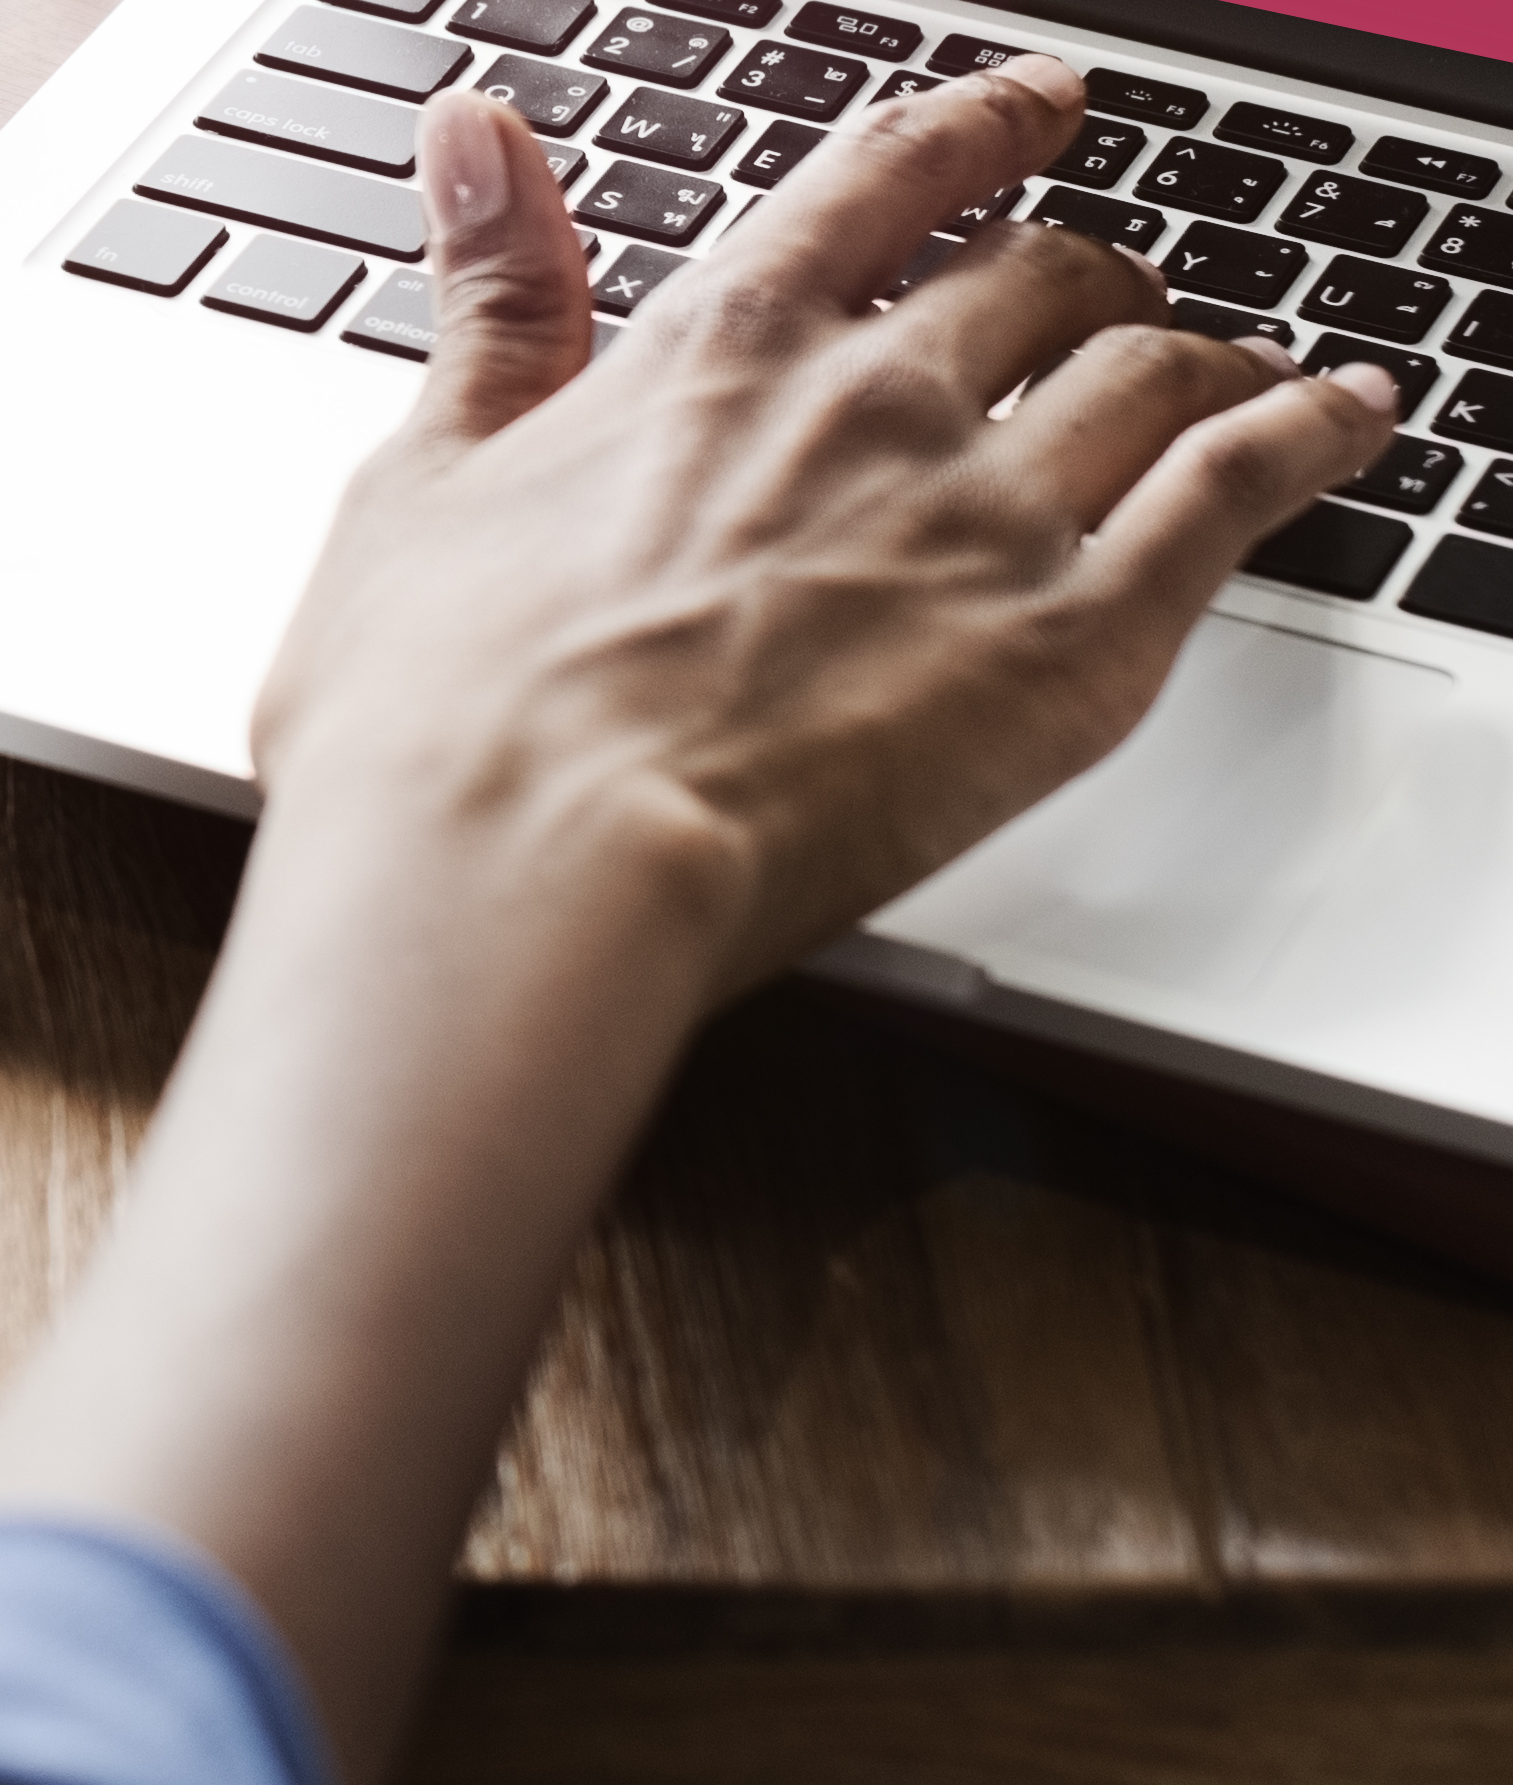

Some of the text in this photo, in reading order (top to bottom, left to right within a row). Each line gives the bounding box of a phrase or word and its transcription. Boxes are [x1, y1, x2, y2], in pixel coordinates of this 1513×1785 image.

[739, 4, 758, 14] F2
[284, 40, 322, 59] tab
[603, 37, 630, 54] 2
[880, 37, 898, 47] F3
[742, 71, 765, 86] 3
[223, 103, 277, 127] caps
[1166, 105, 1185, 115] F5
[282, 118, 331, 141] lock
[621, 116, 661, 138] W
[1310, 140, 1328, 149] F6
[754, 150, 781, 168] E
[160, 170, 214, 194] shift
[1157, 171, 1178, 185] 6
[1457, 173, 1477, 182] F7
[594, 192, 623, 209] S
[1300, 202, 1325, 217] 7
[95, 246, 118, 262] fn
[1441, 238, 1464, 253] 8
[1183, 252, 1208, 270] Y
[226, 279, 309, 309] control
[606, 276, 643, 298] X
[1320, 286, 1353, 306] U
[1450, 401, 1483, 422] K
